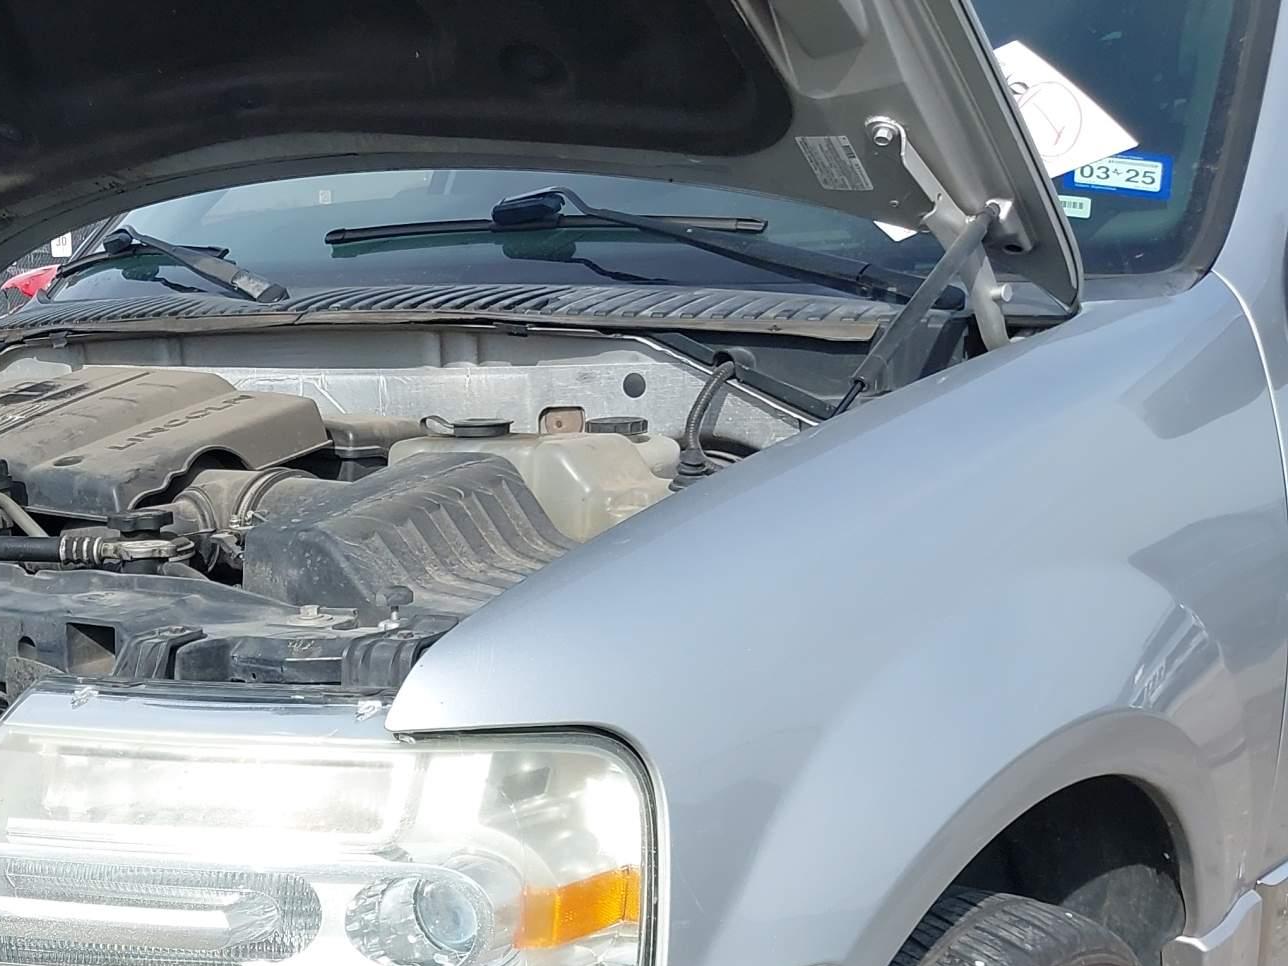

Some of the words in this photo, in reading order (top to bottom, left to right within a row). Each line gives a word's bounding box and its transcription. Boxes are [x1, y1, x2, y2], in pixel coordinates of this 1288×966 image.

[1079, 163, 1111, 181] 03
[1125, 168, 1157, 186] 25
[107, 394, 255, 451] LINCOLN
